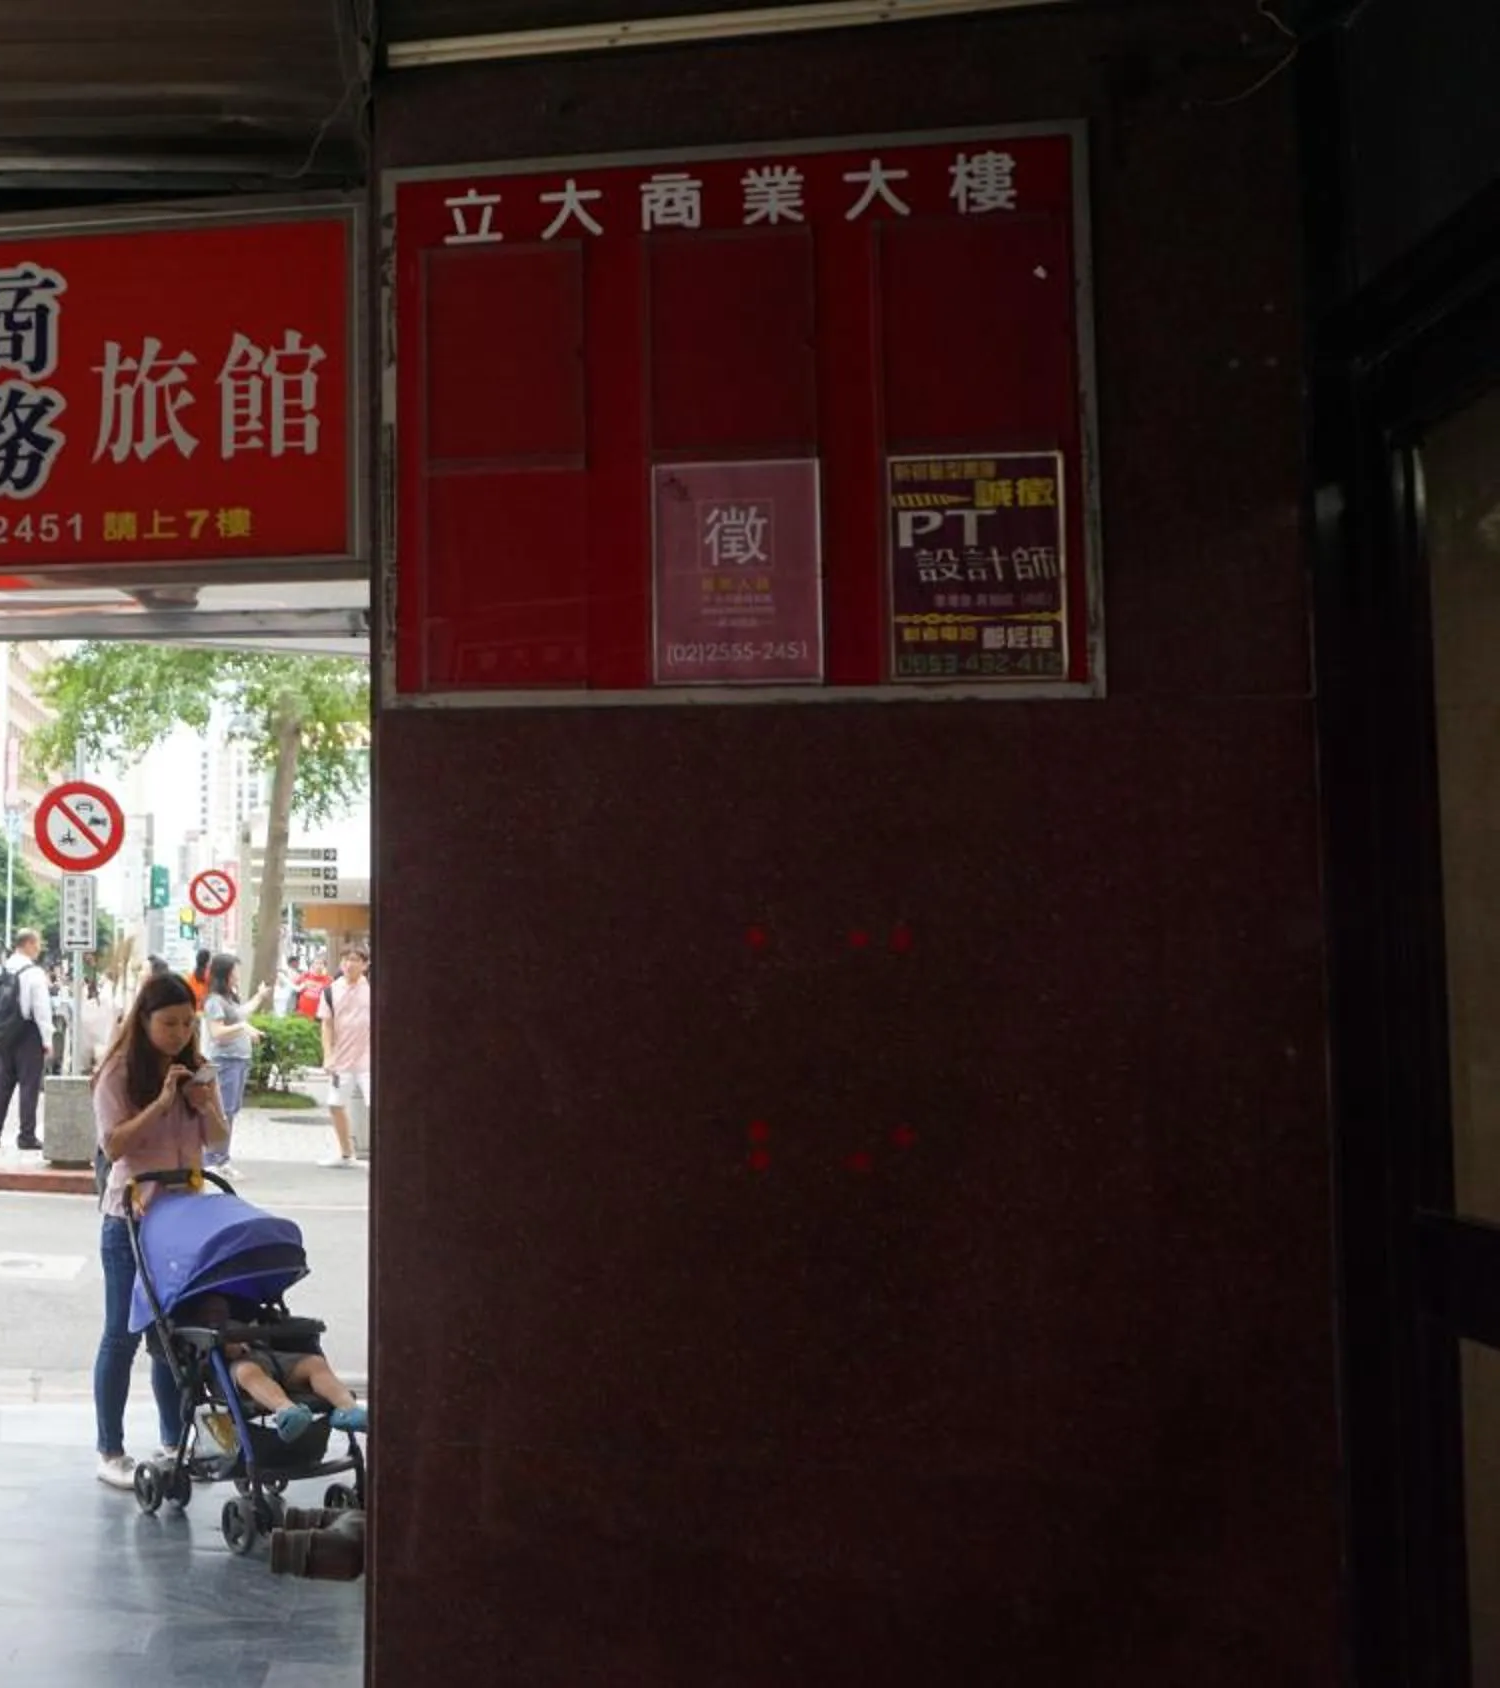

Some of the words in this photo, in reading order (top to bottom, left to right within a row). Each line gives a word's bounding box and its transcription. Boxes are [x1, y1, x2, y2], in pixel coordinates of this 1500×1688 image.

[444, 151, 1016, 244] 立大商業大樓
[91, 330, 326, 464] 旅館
[104, 508, 252, 542] 請上7樓
[705, 506, 768, 566] 徵
[898, 510, 997, 548] PT
[916, 546, 1057, 581] 設計師
[666, 640, 808, 665] (02)2555-2451
